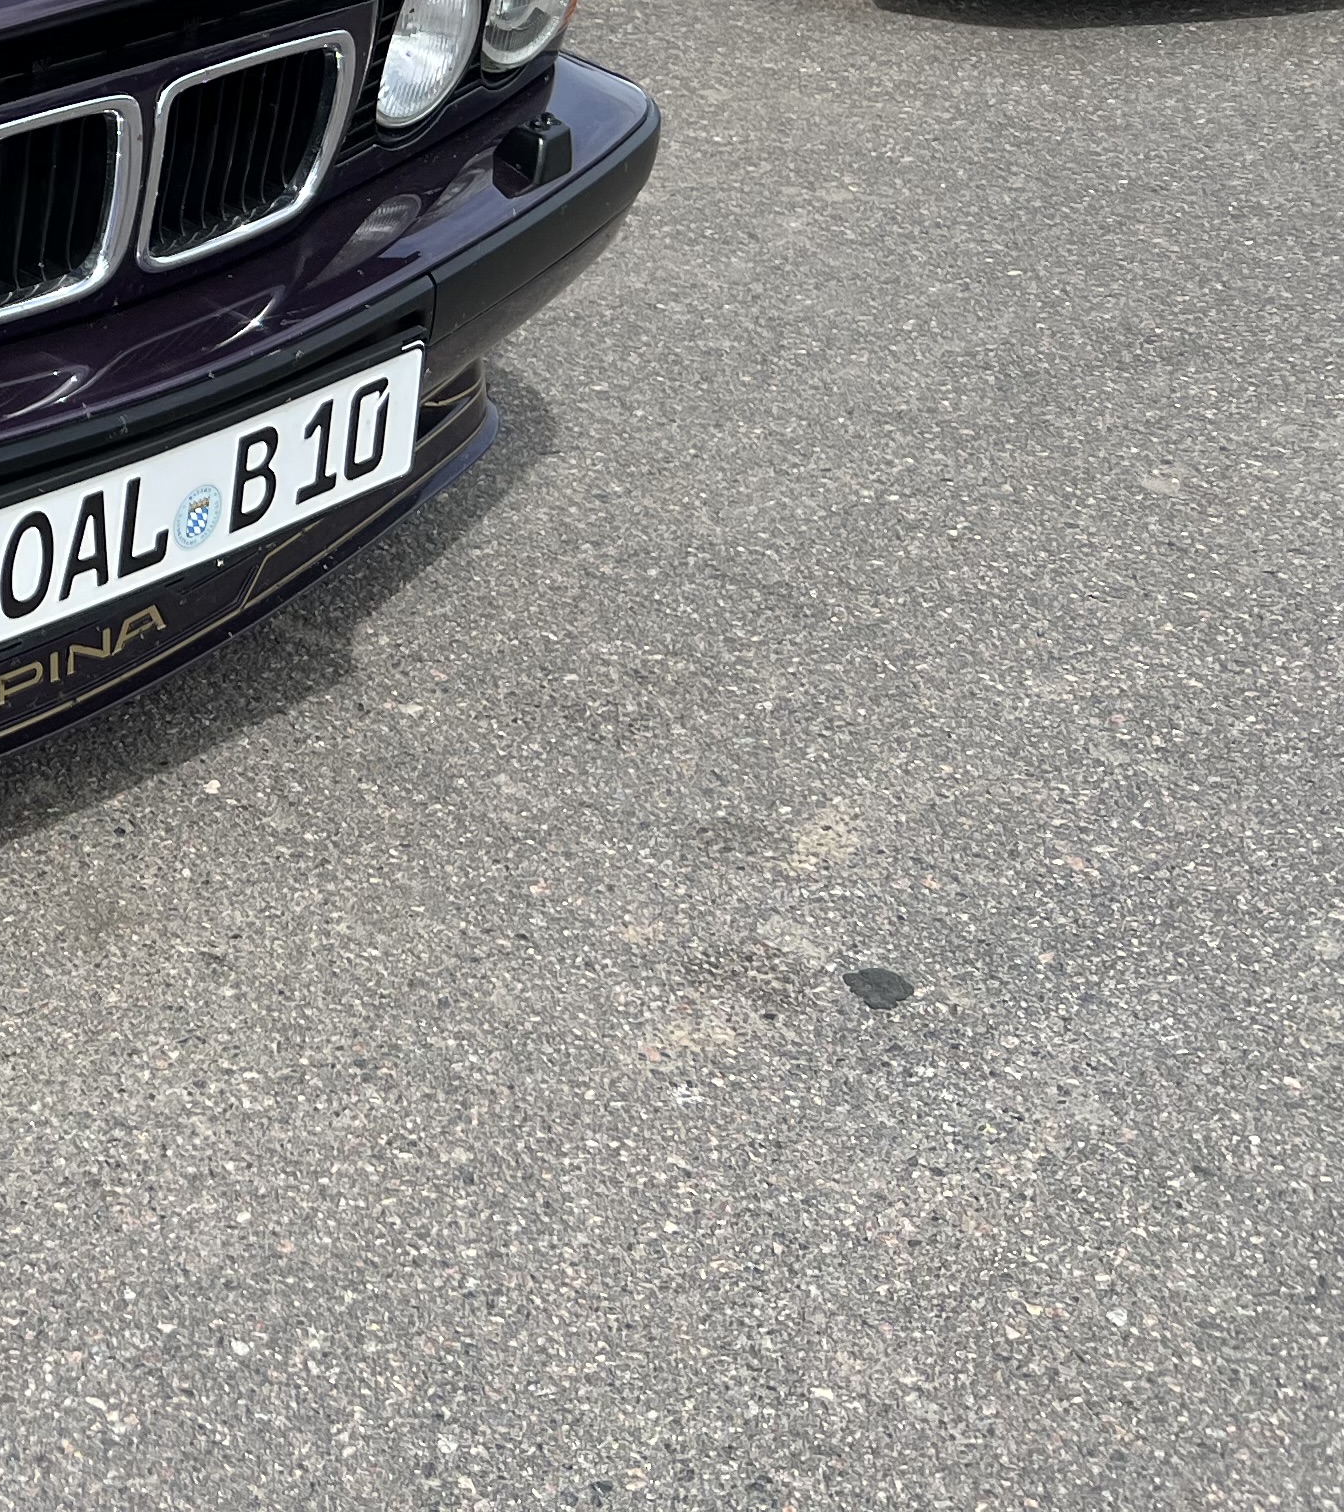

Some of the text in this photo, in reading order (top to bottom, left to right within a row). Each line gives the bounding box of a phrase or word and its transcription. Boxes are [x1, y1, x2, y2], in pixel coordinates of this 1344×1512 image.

[0, 477, 170, 620] OAL
[229, 426, 280, 534] B
[295, 376, 390, 506] 10
